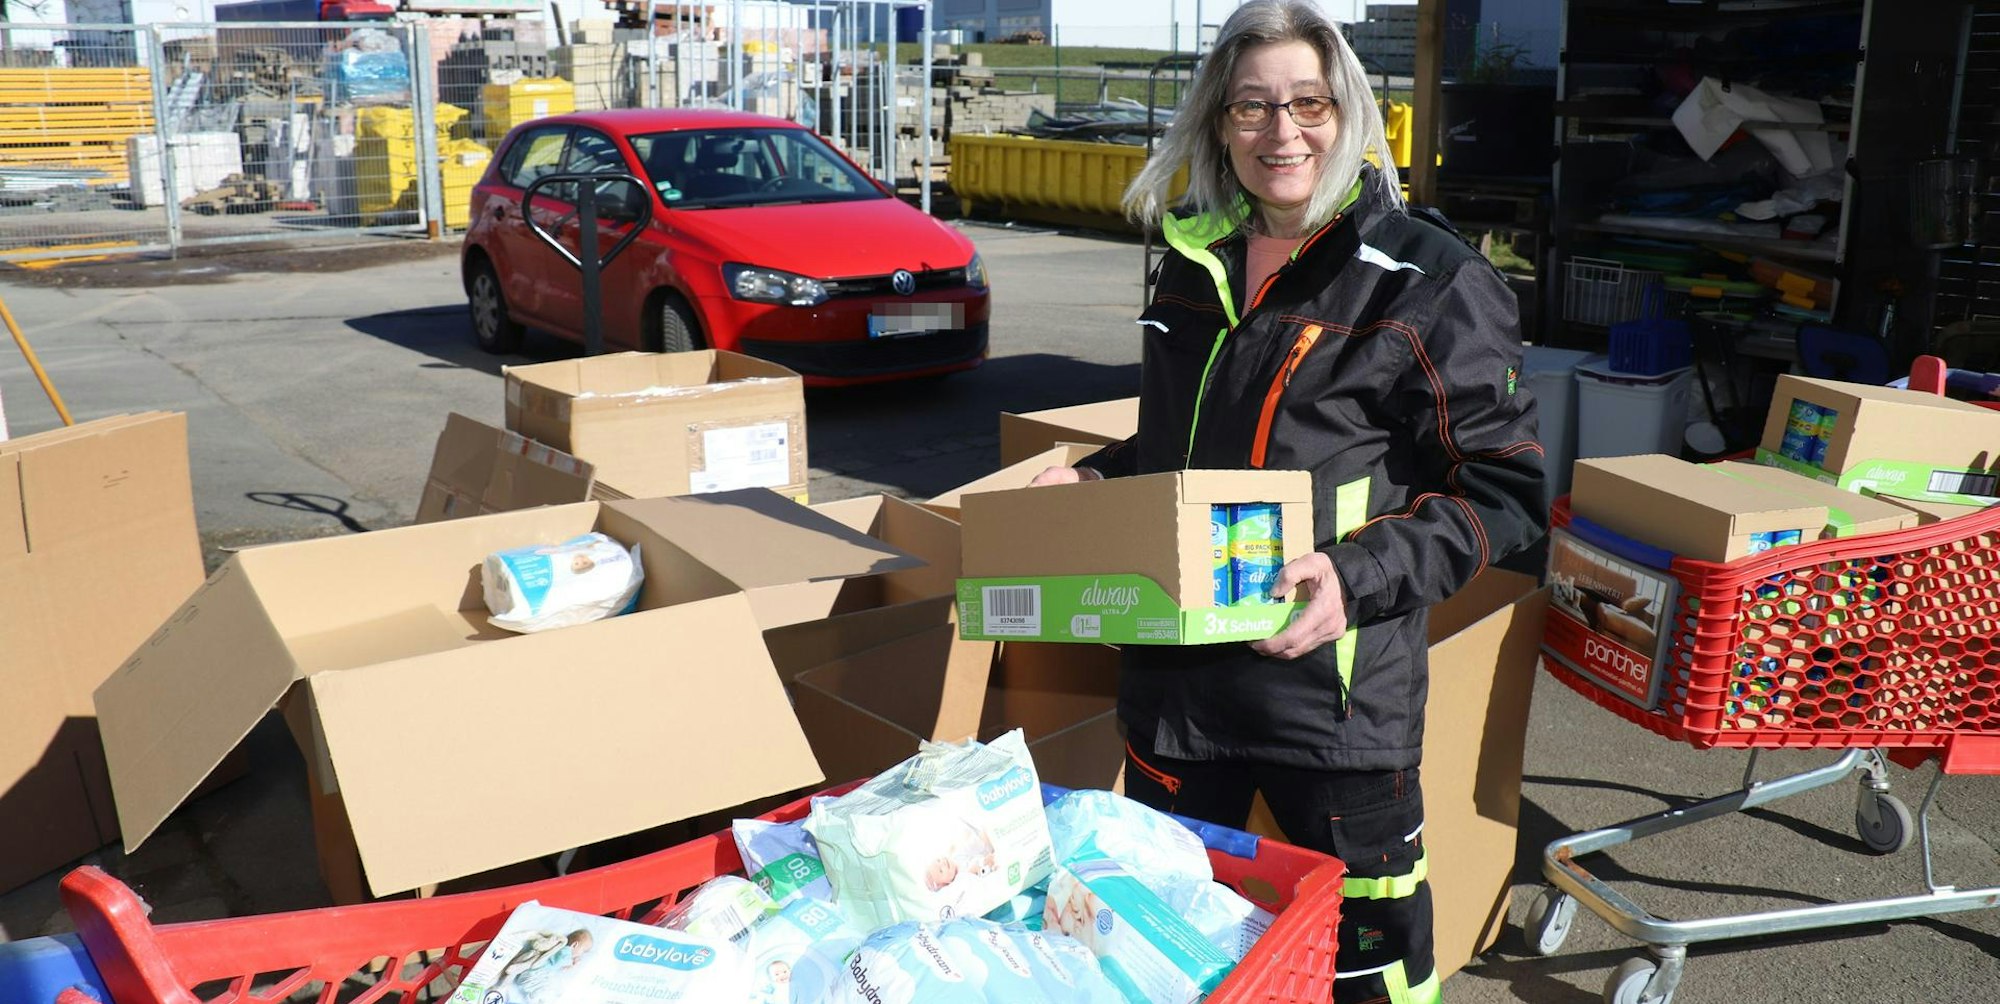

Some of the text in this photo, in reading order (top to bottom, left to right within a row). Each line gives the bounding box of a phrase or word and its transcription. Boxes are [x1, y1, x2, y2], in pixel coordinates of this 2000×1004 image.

[1080, 578, 1140, 615] always
[1203, 611, 1275, 635] 3x Schutz
[1584, 638, 1648, 683] panthel
[981, 769, 1032, 806] babylove
[619, 939, 705, 967] babylove
